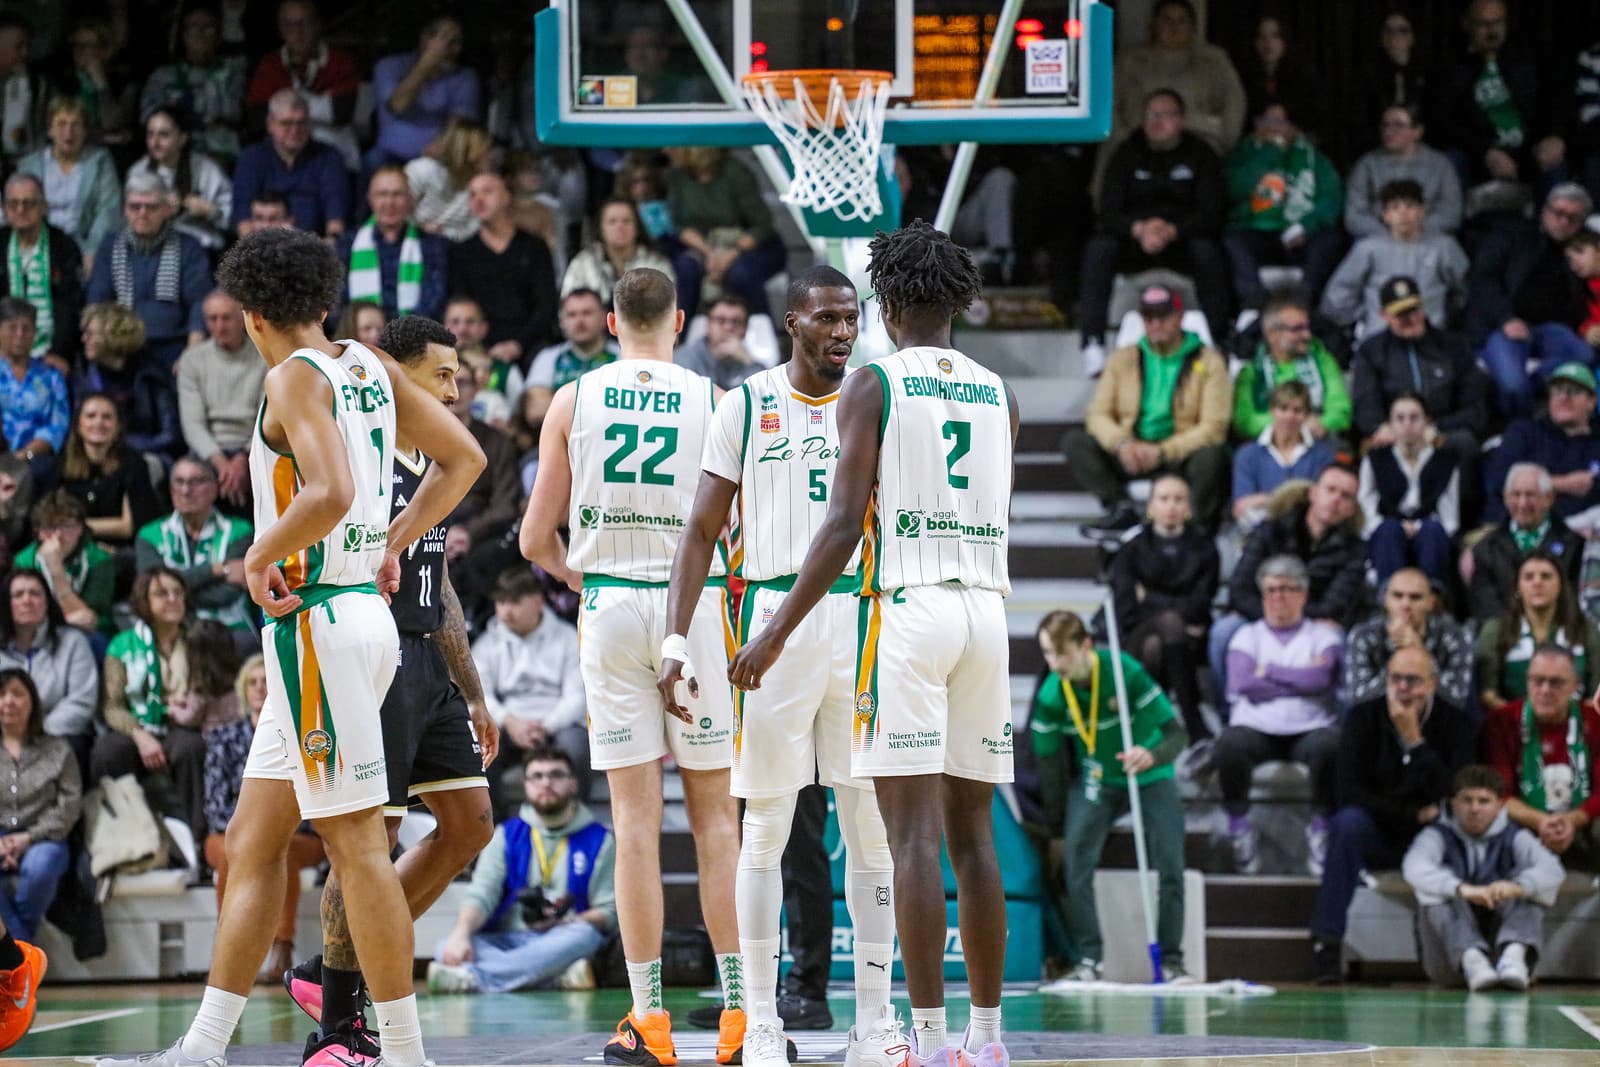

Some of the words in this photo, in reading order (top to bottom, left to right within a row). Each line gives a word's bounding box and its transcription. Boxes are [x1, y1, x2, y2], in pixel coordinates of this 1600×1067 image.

[604, 387, 681, 414] BOYER
[760, 422, 780, 430] KING
[370, 428, 384, 496] 1
[603, 422, 679, 486] 22
[758, 437, 796, 463] Le
[801, 436, 841, 460] Por
[942, 420, 971, 489] 2
[809, 469, 827, 501] 5
[608, 506, 632, 514] agglo
[423, 542, 445, 552] ASVEL
[418, 564, 432, 607] 11
[888, 732, 916, 741] Thierry
